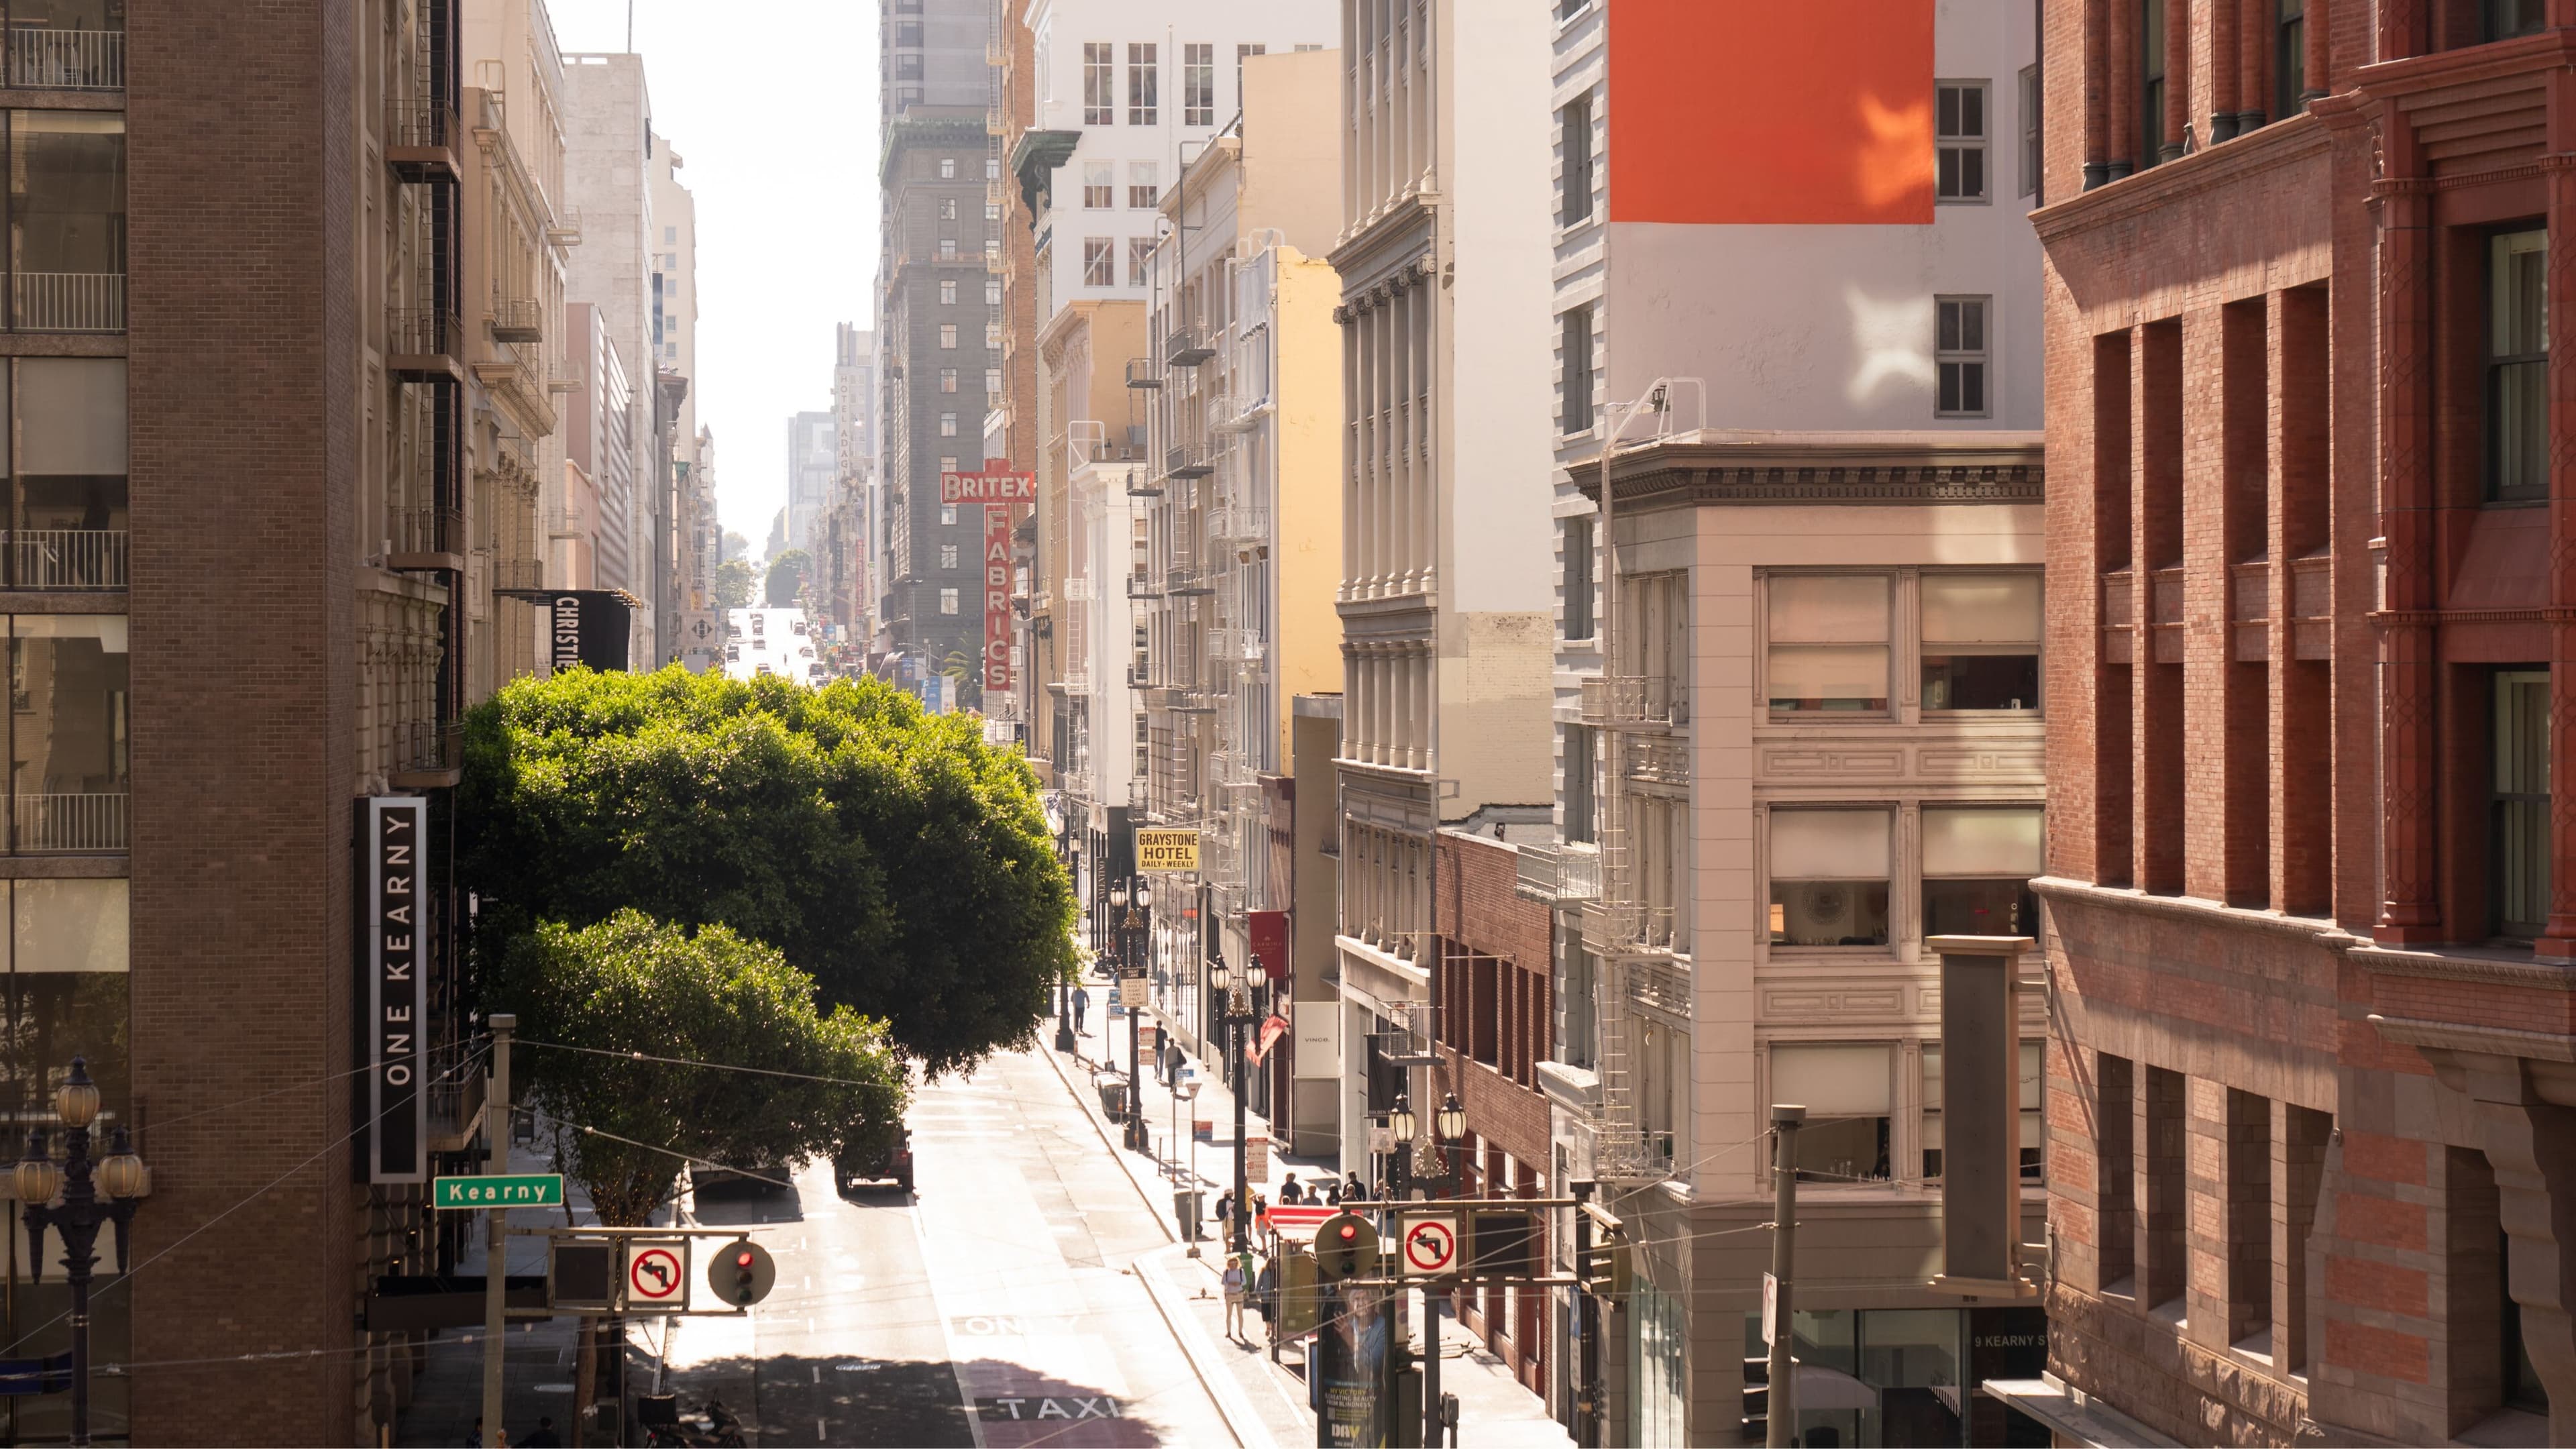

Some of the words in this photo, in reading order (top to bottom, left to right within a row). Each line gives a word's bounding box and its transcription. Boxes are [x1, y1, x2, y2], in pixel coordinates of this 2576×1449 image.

[945, 475, 1030, 500] BRITEX
[987, 511, 1007, 685] FABRICS
[1139, 834, 1197, 846] GRAYSTONE
[1144, 847, 1192, 859] HOTEL
[387, 816, 410, 979] KEARNY
[387, 1006, 410, 1085] ONE
[449, 1184, 547, 1202] Kearny
[1975, 1336, 1982, 1347] 9
[1985, 1335, 2034, 1347] KEARNY
[996, 1397, 1121, 1419] TAXI
[1332, 1423, 1360, 1438] DAV
